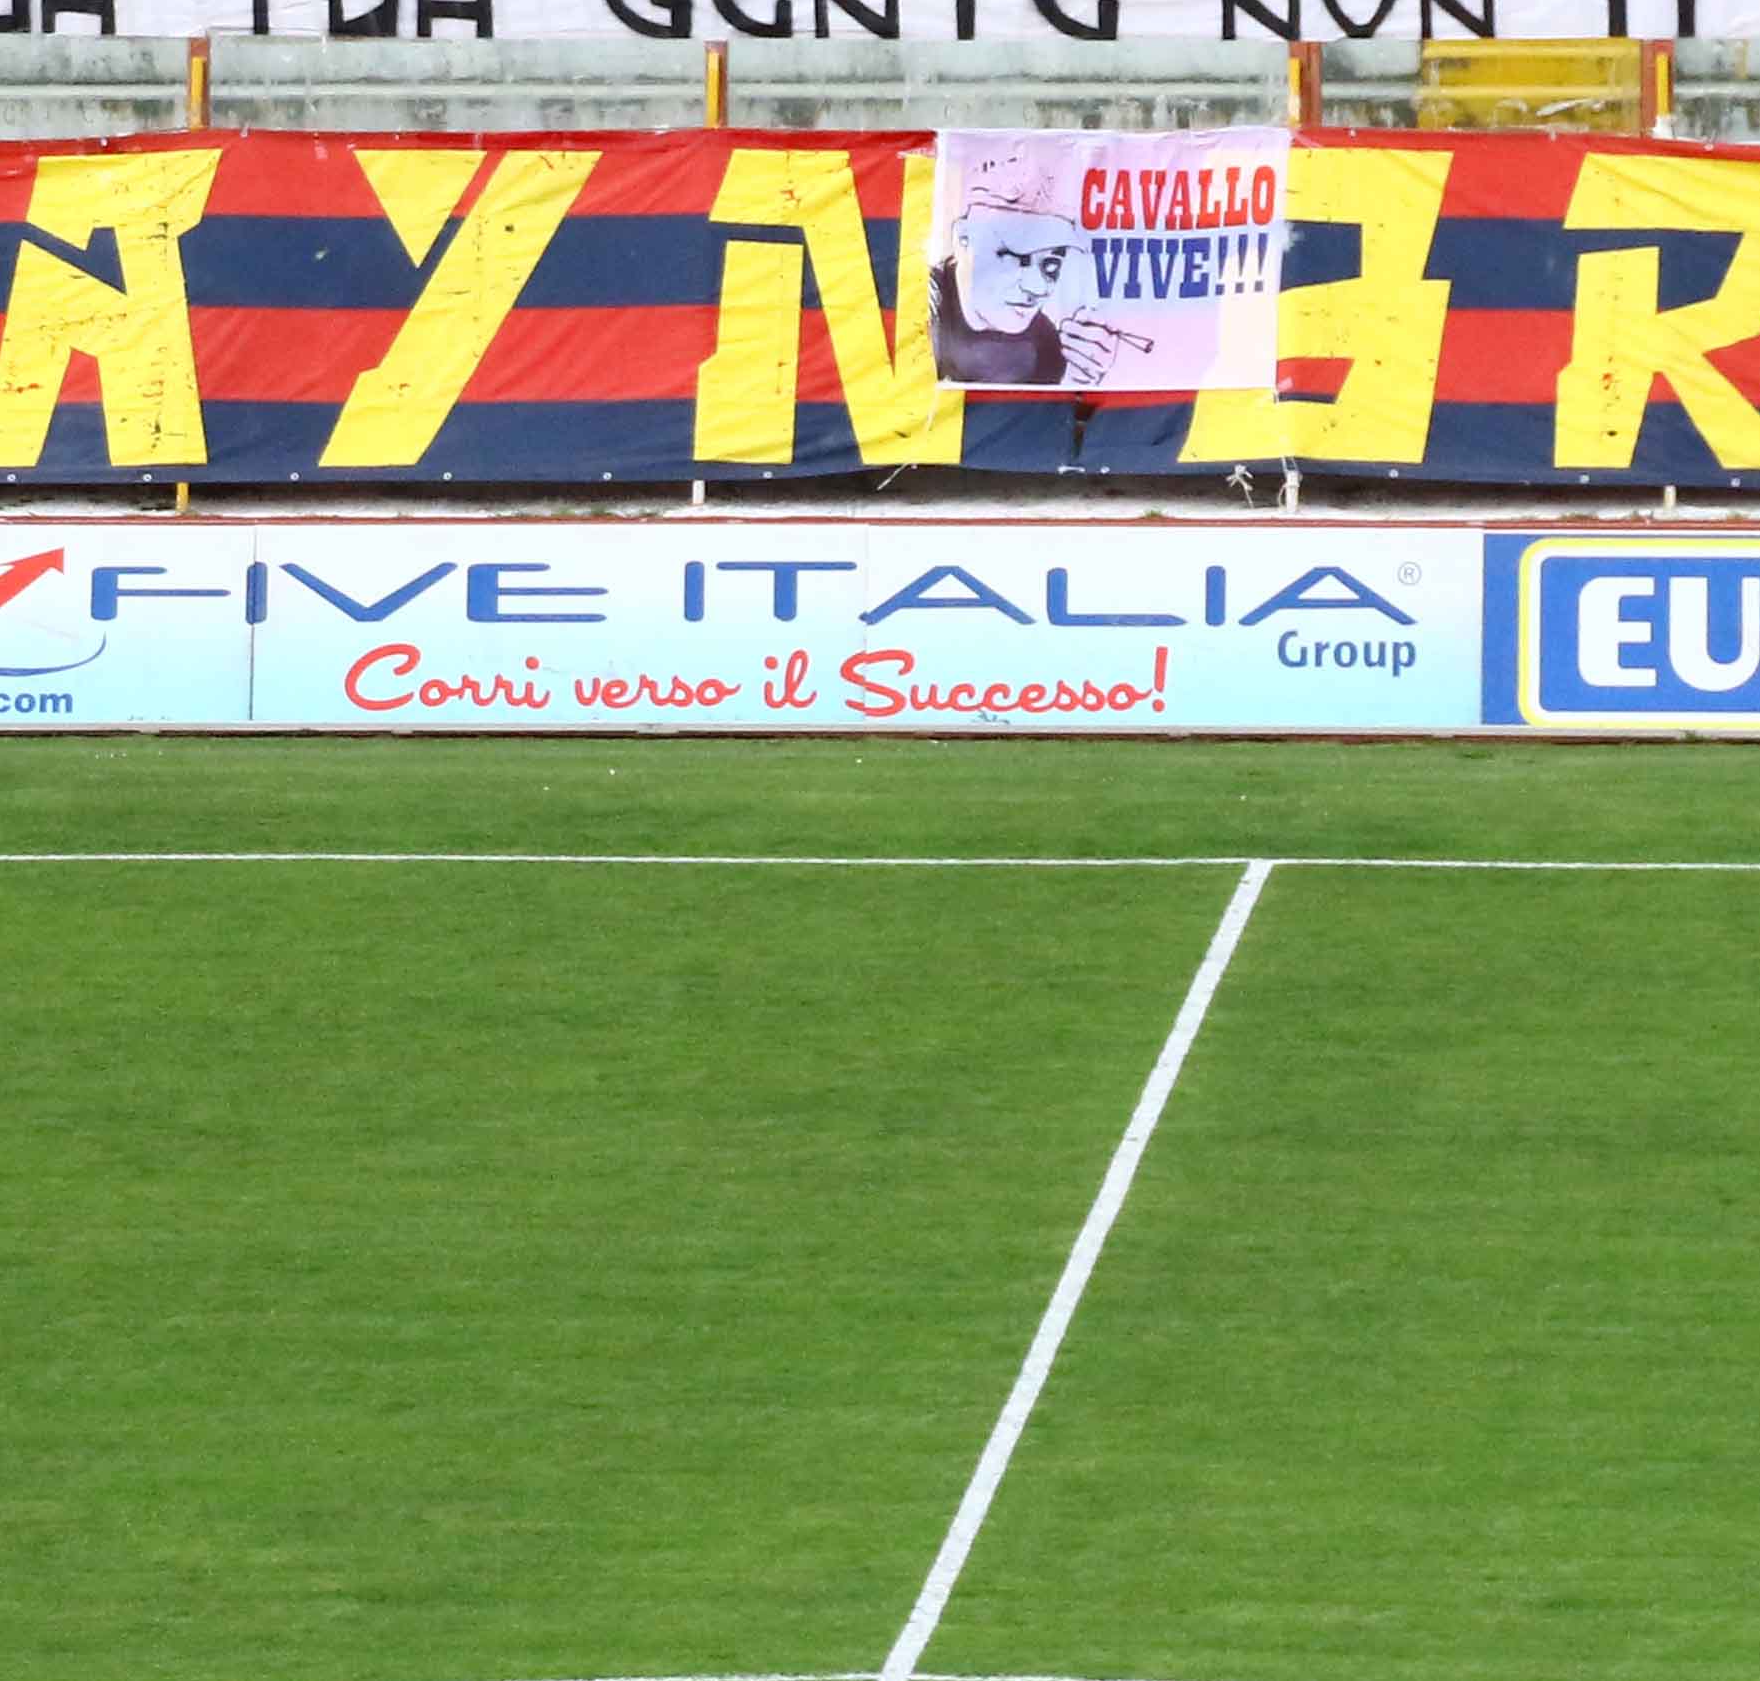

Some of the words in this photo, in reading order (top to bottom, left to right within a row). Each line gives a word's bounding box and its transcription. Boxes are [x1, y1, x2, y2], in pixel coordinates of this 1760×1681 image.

[1081, 166, 1277, 231] CAVALLO
[1090, 233, 1270, 300] VIVE!!!
[89, 562, 607, 625] FIVE
[683, 561, 1418, 626] ITALIA
[345, 643, 550, 713] Corri
[573, 669, 741, 713] verso
[763, 648, 819, 713] il
[839, 646, 1170, 717] Successo!
[1276, 629, 1418, 676] Group
